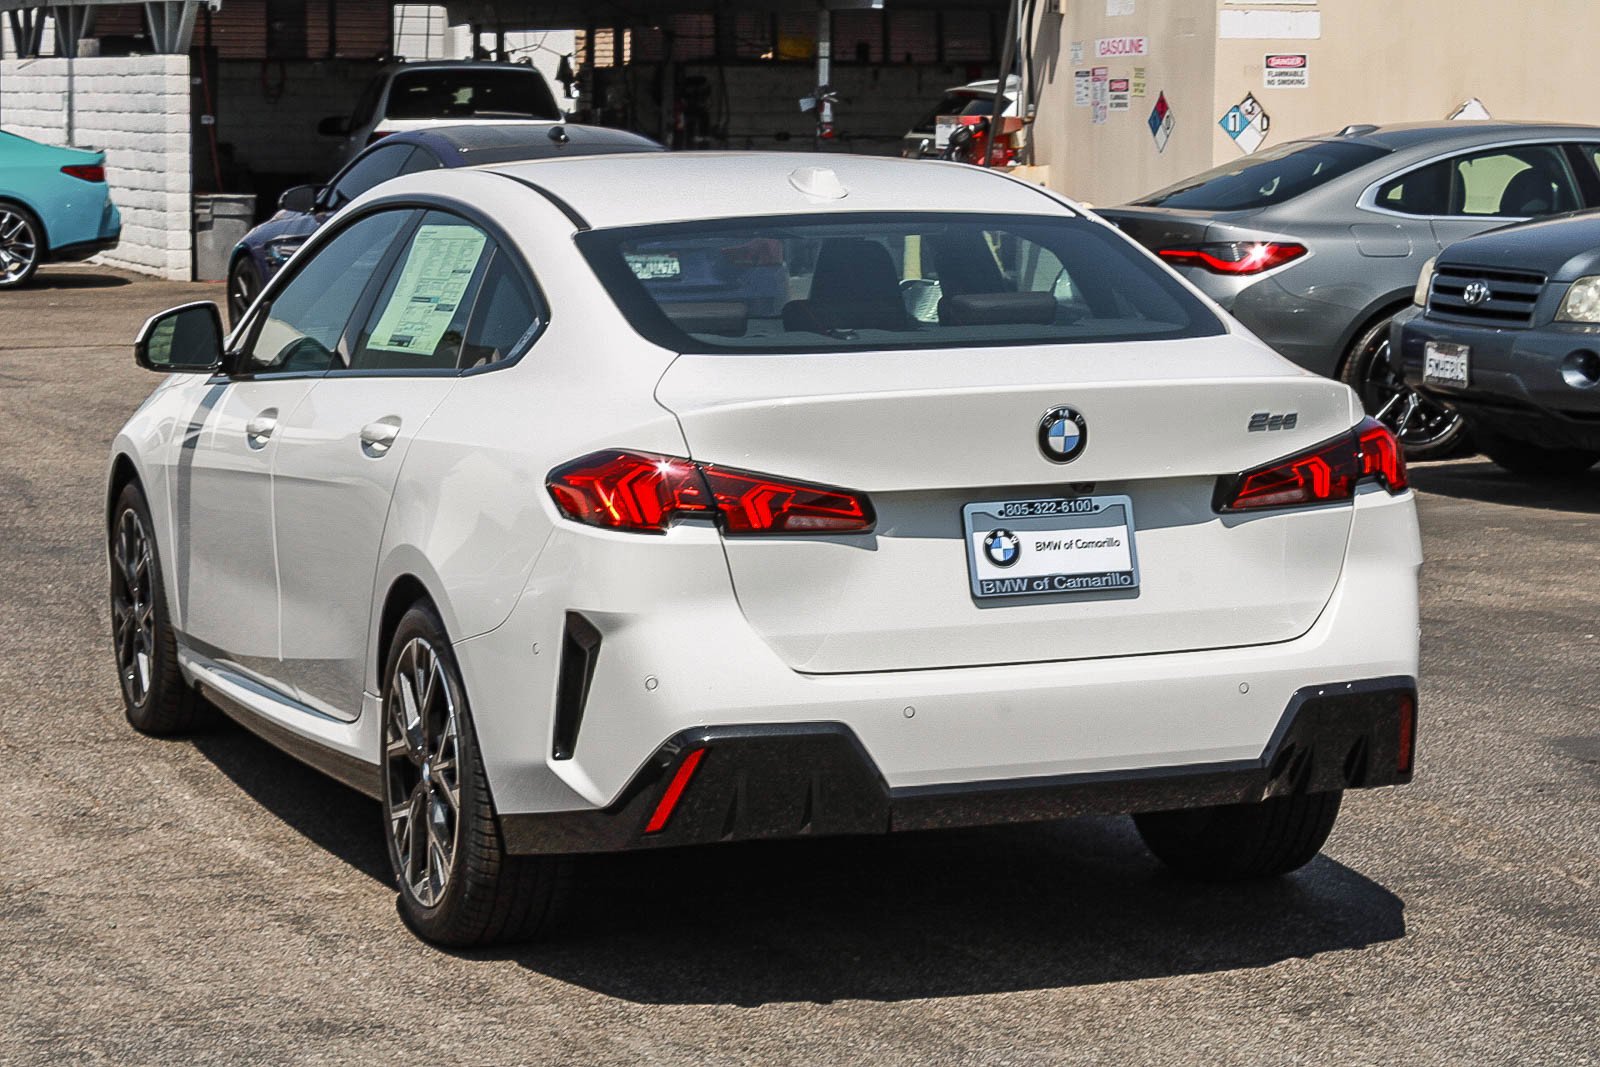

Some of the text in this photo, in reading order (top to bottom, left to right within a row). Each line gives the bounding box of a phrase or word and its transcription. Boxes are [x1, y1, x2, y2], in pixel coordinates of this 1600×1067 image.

[1099, 38, 1144, 56] GASOLINE
[1267, 70, 1305, 78] FLAMMABLE
[1231, 114, 1238, 132] 1
[1005, 500, 1092, 516] 805-322-6100
[1035, 537, 1121, 552] BMW of Camarillo
[982, 573, 1132, 594] BMW of Camarillo
